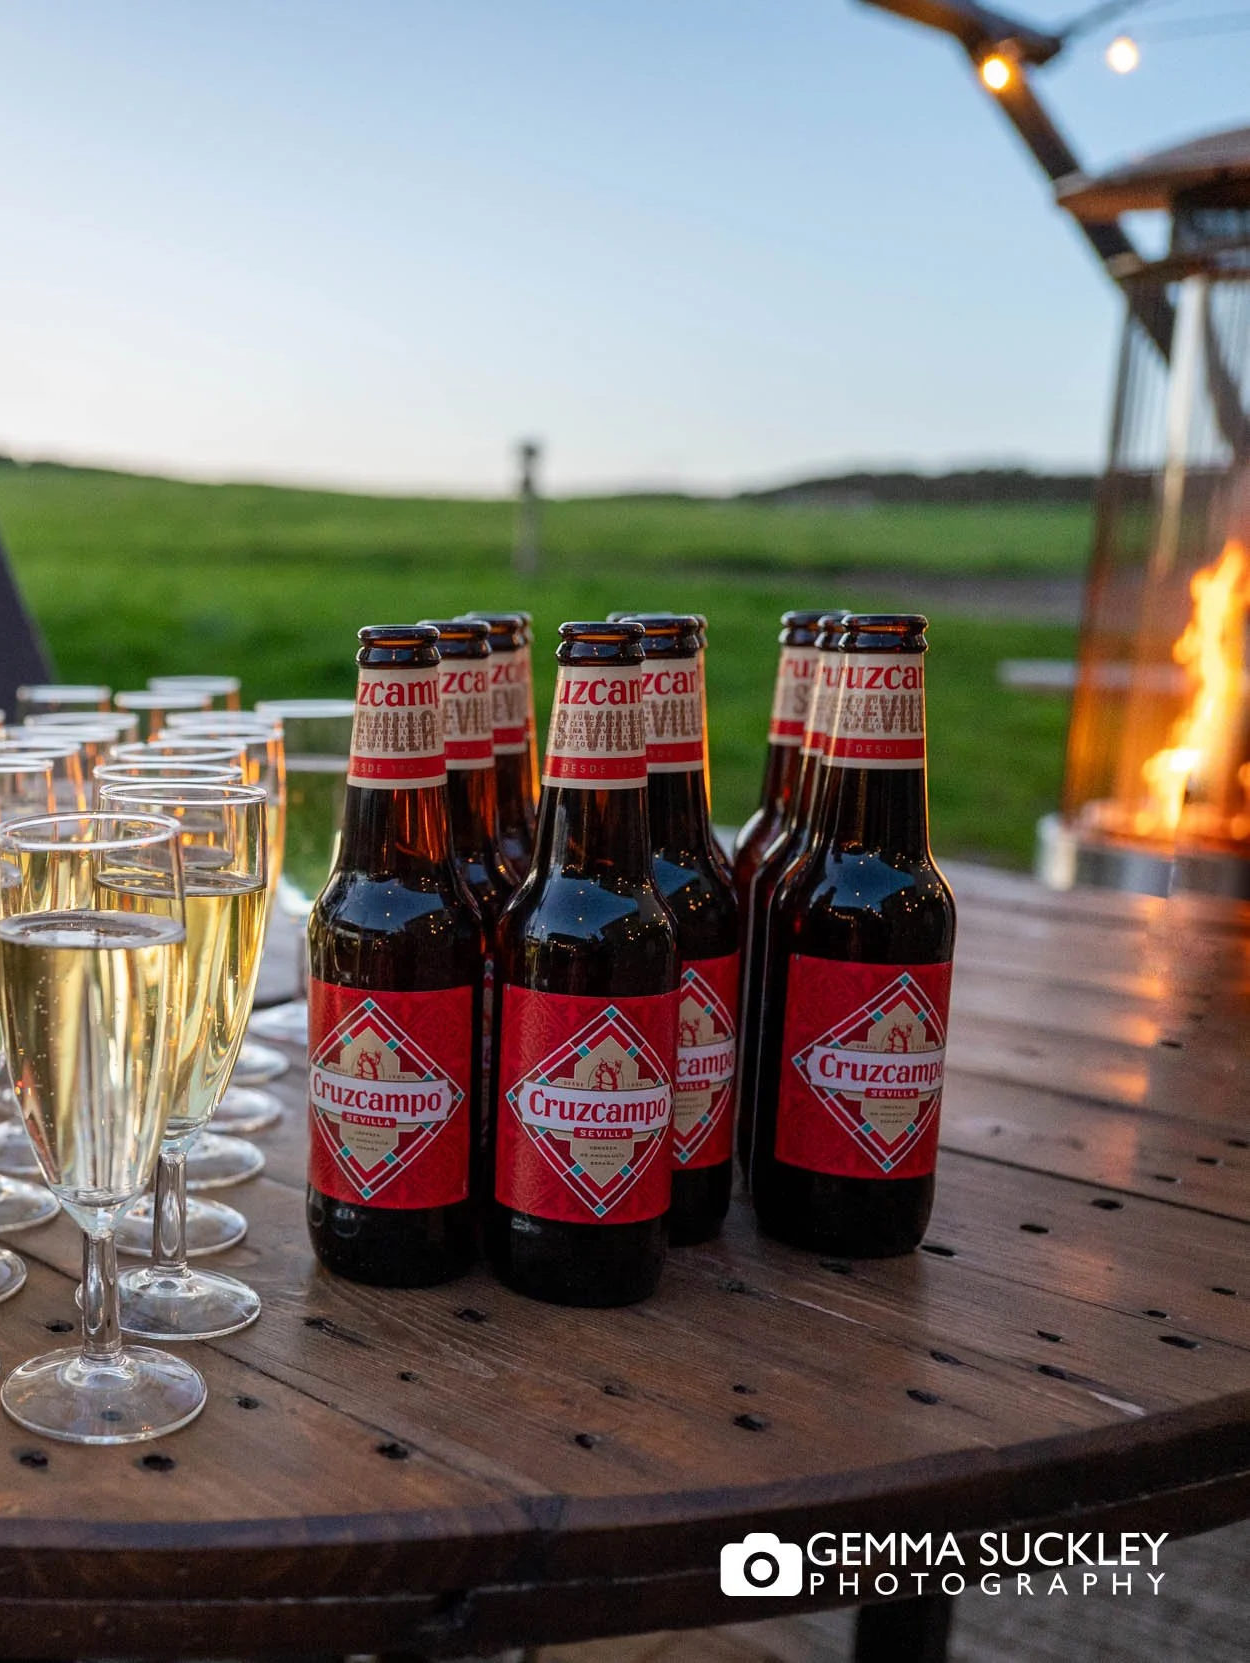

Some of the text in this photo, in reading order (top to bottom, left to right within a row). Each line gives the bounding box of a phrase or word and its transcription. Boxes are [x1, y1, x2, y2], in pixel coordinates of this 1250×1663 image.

[818, 1053, 942, 1086] Cruzcampo
[313, 1071, 442, 1117] Cruzcampo
[529, 1088, 666, 1125] Cruzcampo
[345, 1113, 391, 1126] SEVILLA
[579, 1129, 628, 1138] SEVILLA
